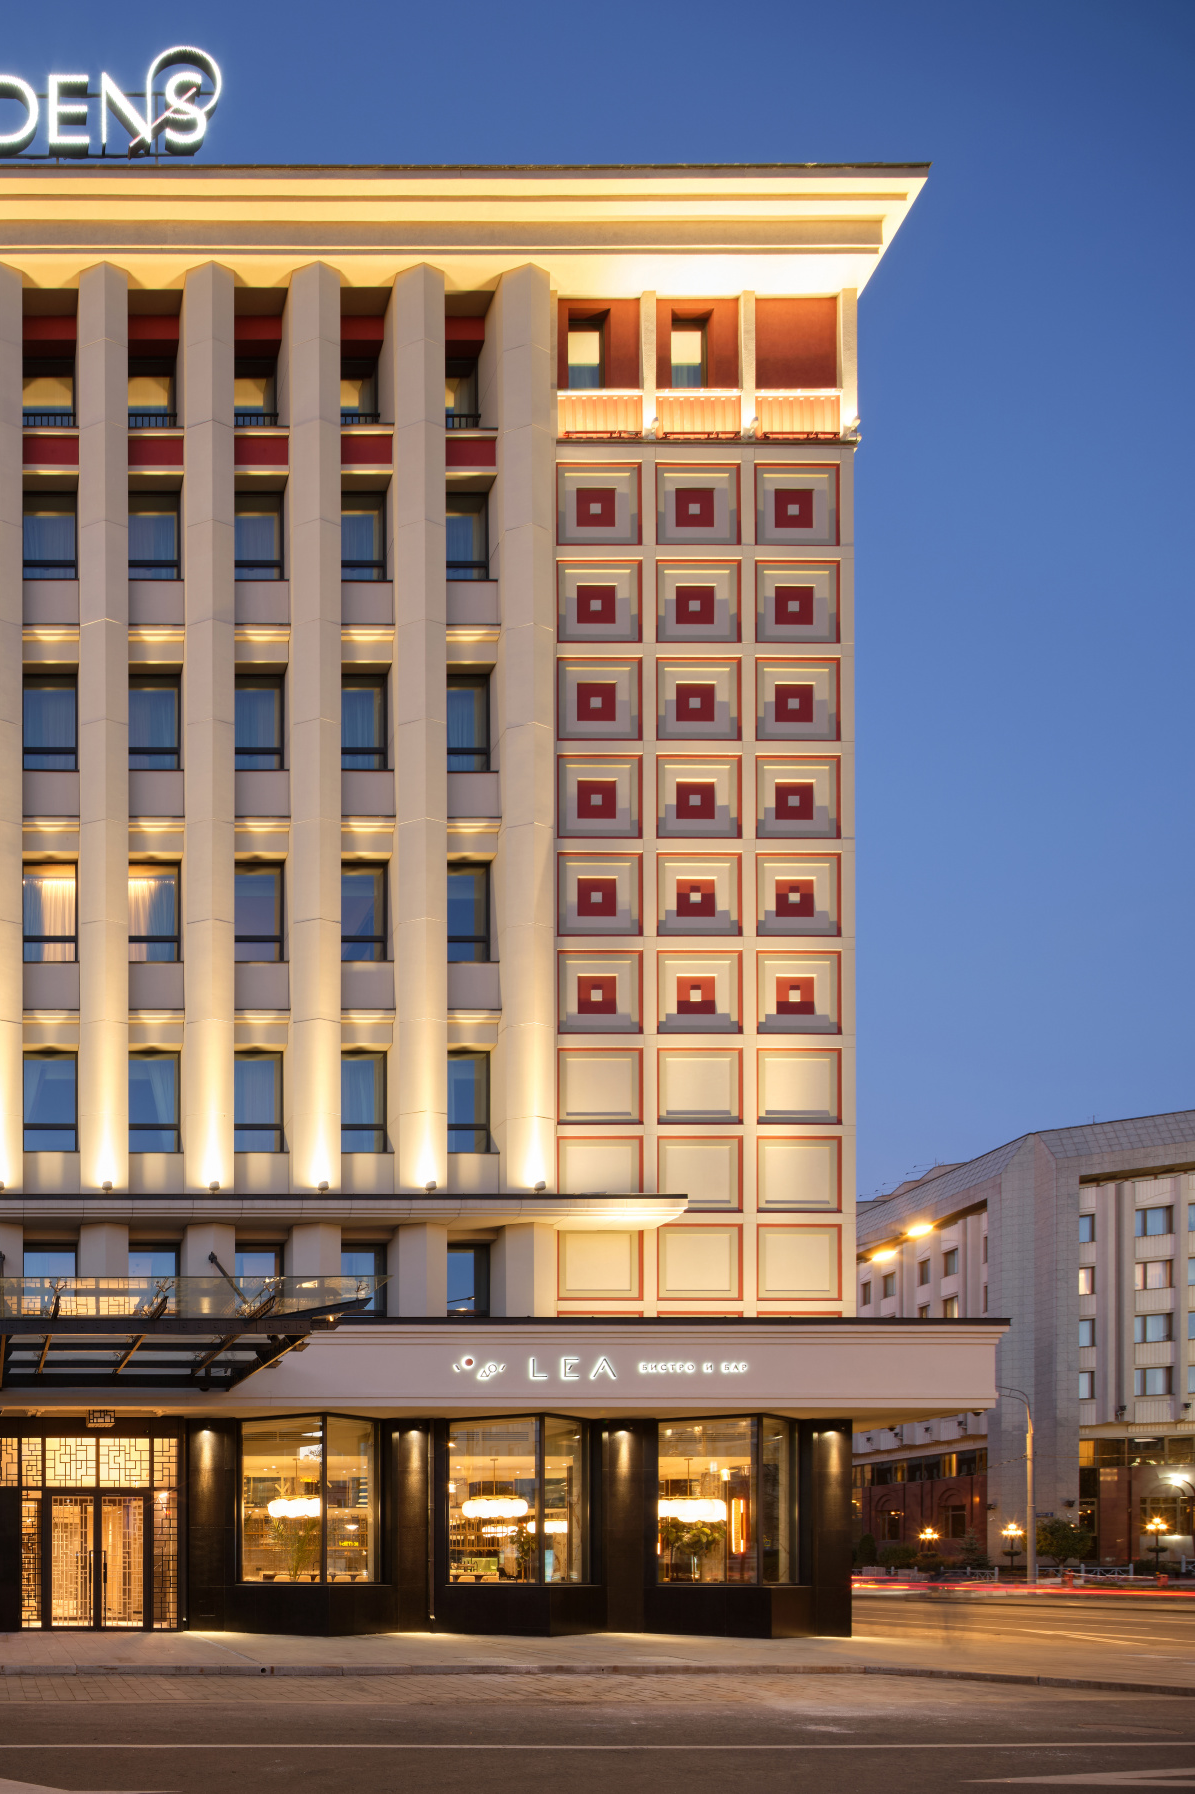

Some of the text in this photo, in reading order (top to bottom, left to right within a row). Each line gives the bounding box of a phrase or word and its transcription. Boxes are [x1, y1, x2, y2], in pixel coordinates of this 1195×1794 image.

[528, 1356, 617, 1379] LEA
[639, 1362, 749, 1373] БИСТРО И БАР
